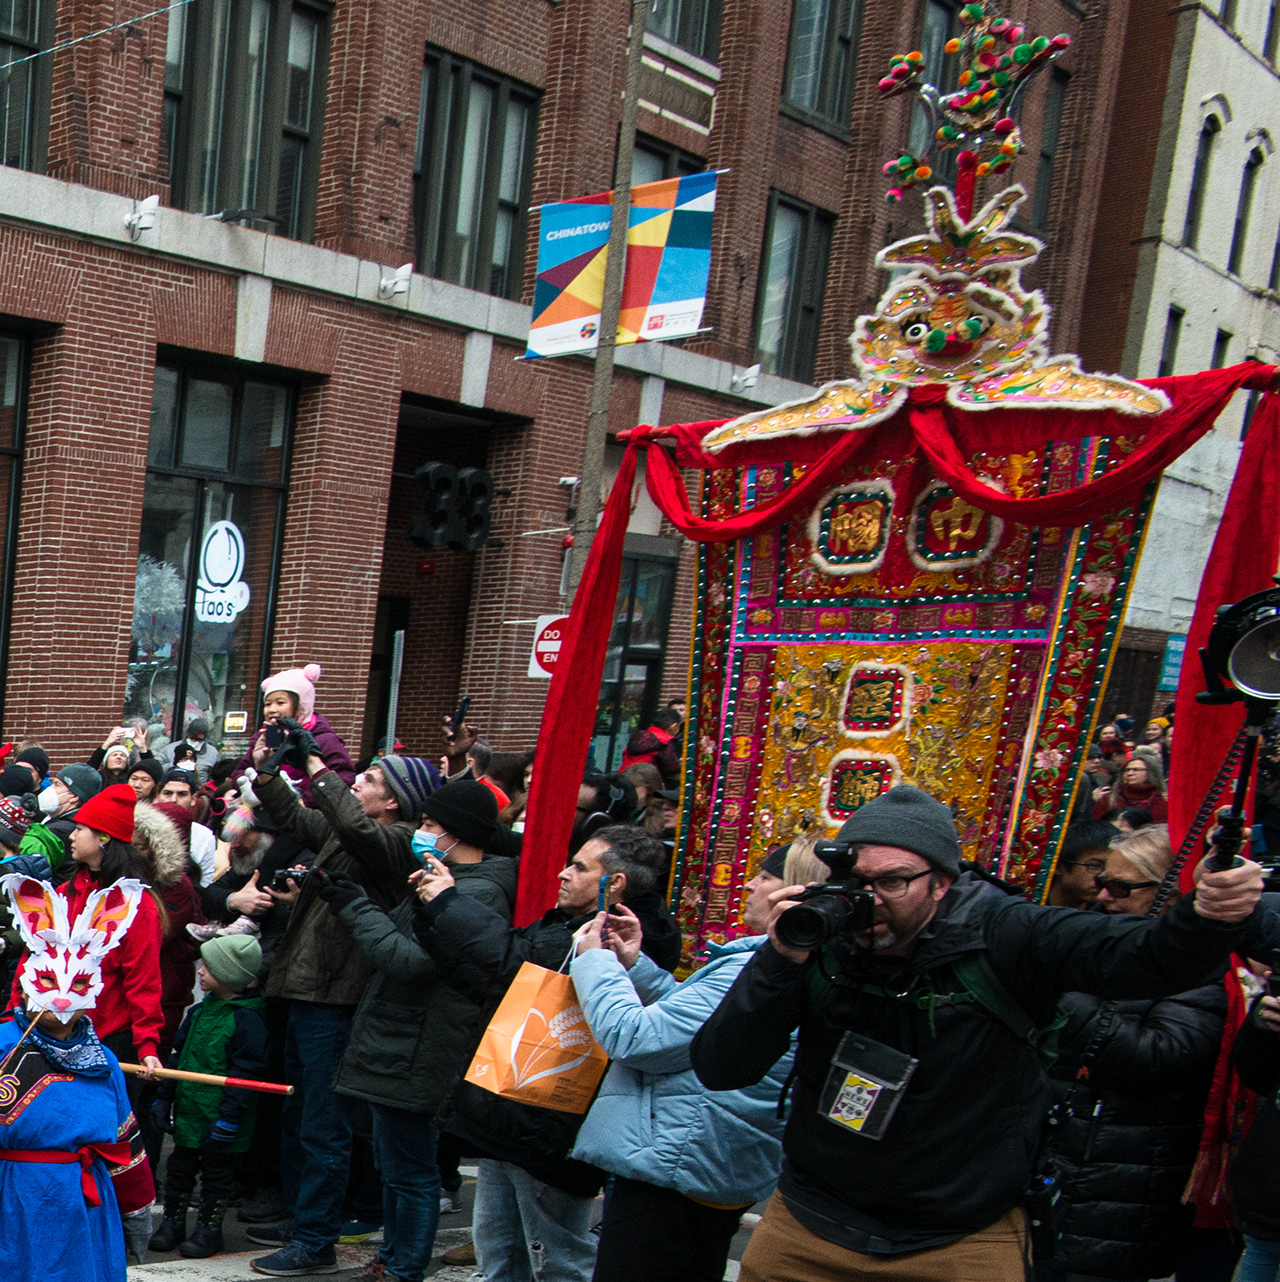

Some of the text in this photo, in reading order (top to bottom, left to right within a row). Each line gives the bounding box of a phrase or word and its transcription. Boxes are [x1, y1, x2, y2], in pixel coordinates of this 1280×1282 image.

[546, 221, 611, 241] CHINATOW
[196, 586, 237, 617] Tao's
[543, 630, 561, 640] DO
[542, 653, 559, 663] EN
